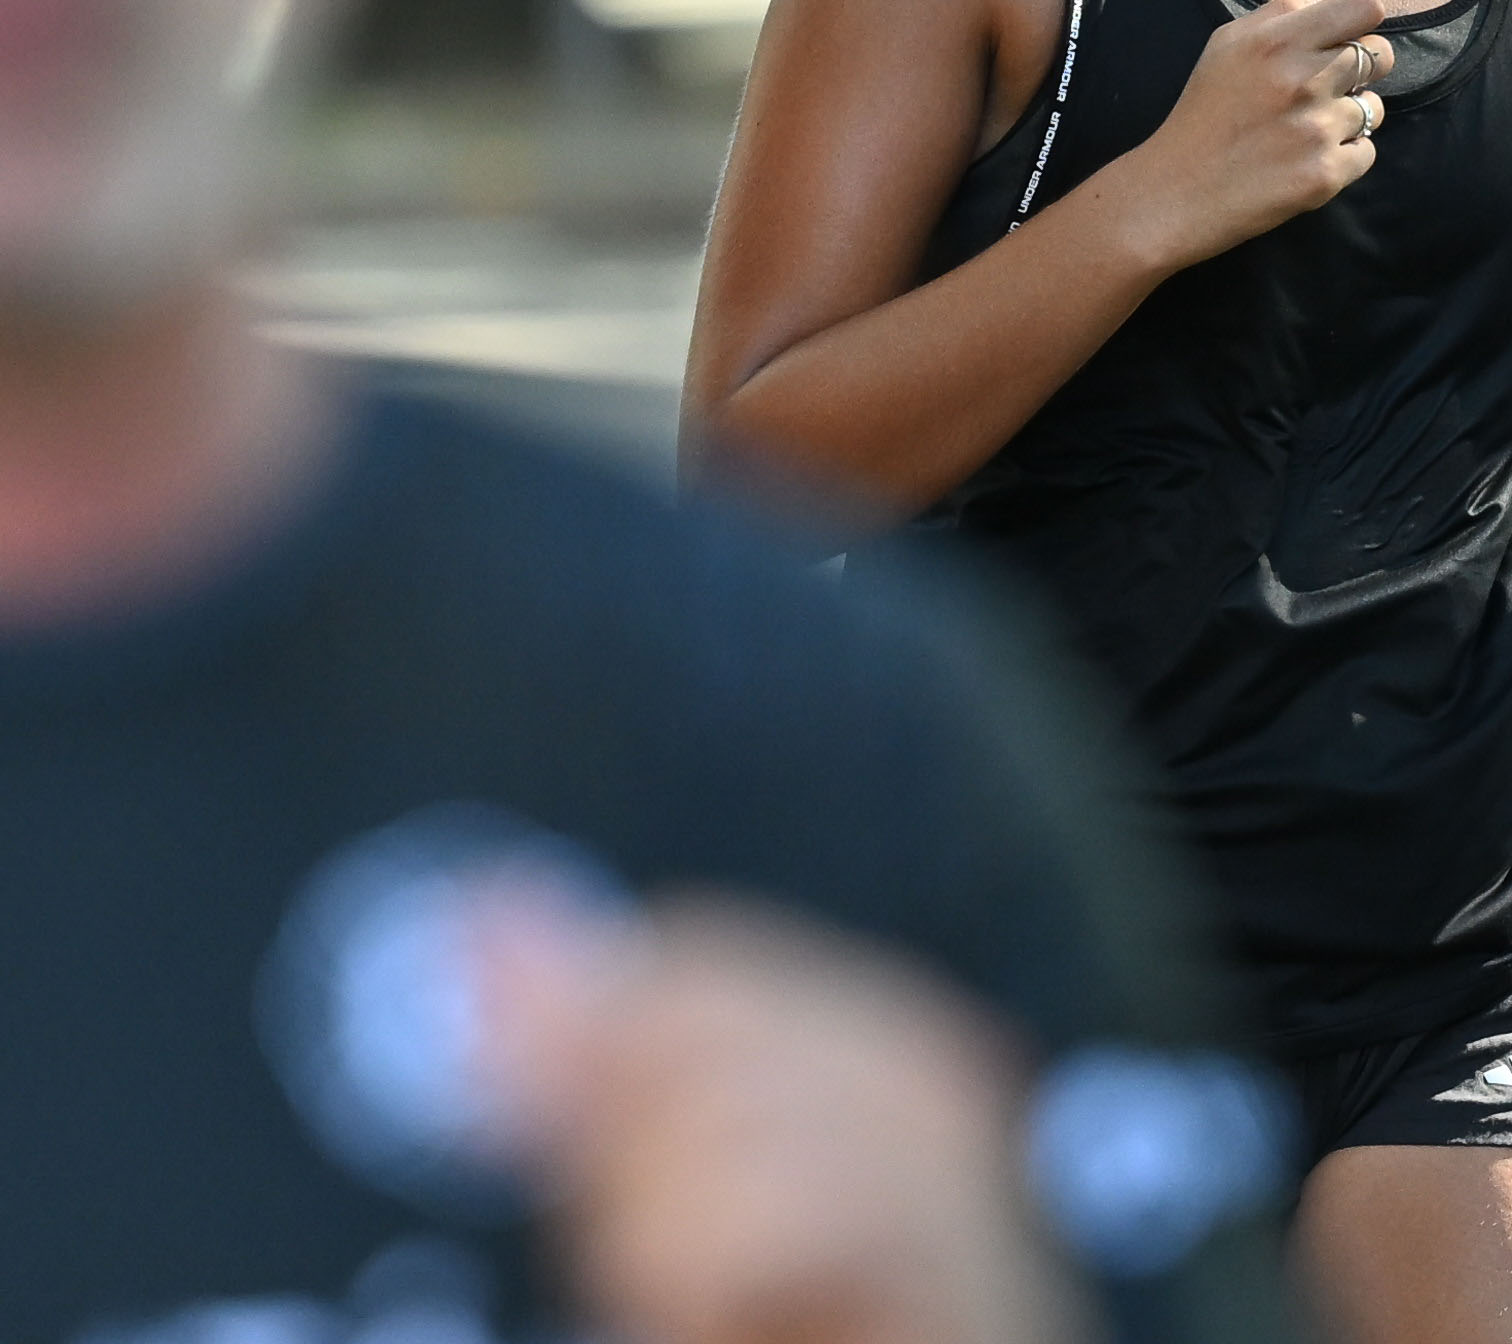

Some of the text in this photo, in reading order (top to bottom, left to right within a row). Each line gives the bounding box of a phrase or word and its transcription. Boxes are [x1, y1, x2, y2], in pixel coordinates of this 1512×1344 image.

[1056, 39, 1077, 103] ARMOUR
[1017, 111, 1062, 214] UNDER ARMOUR
